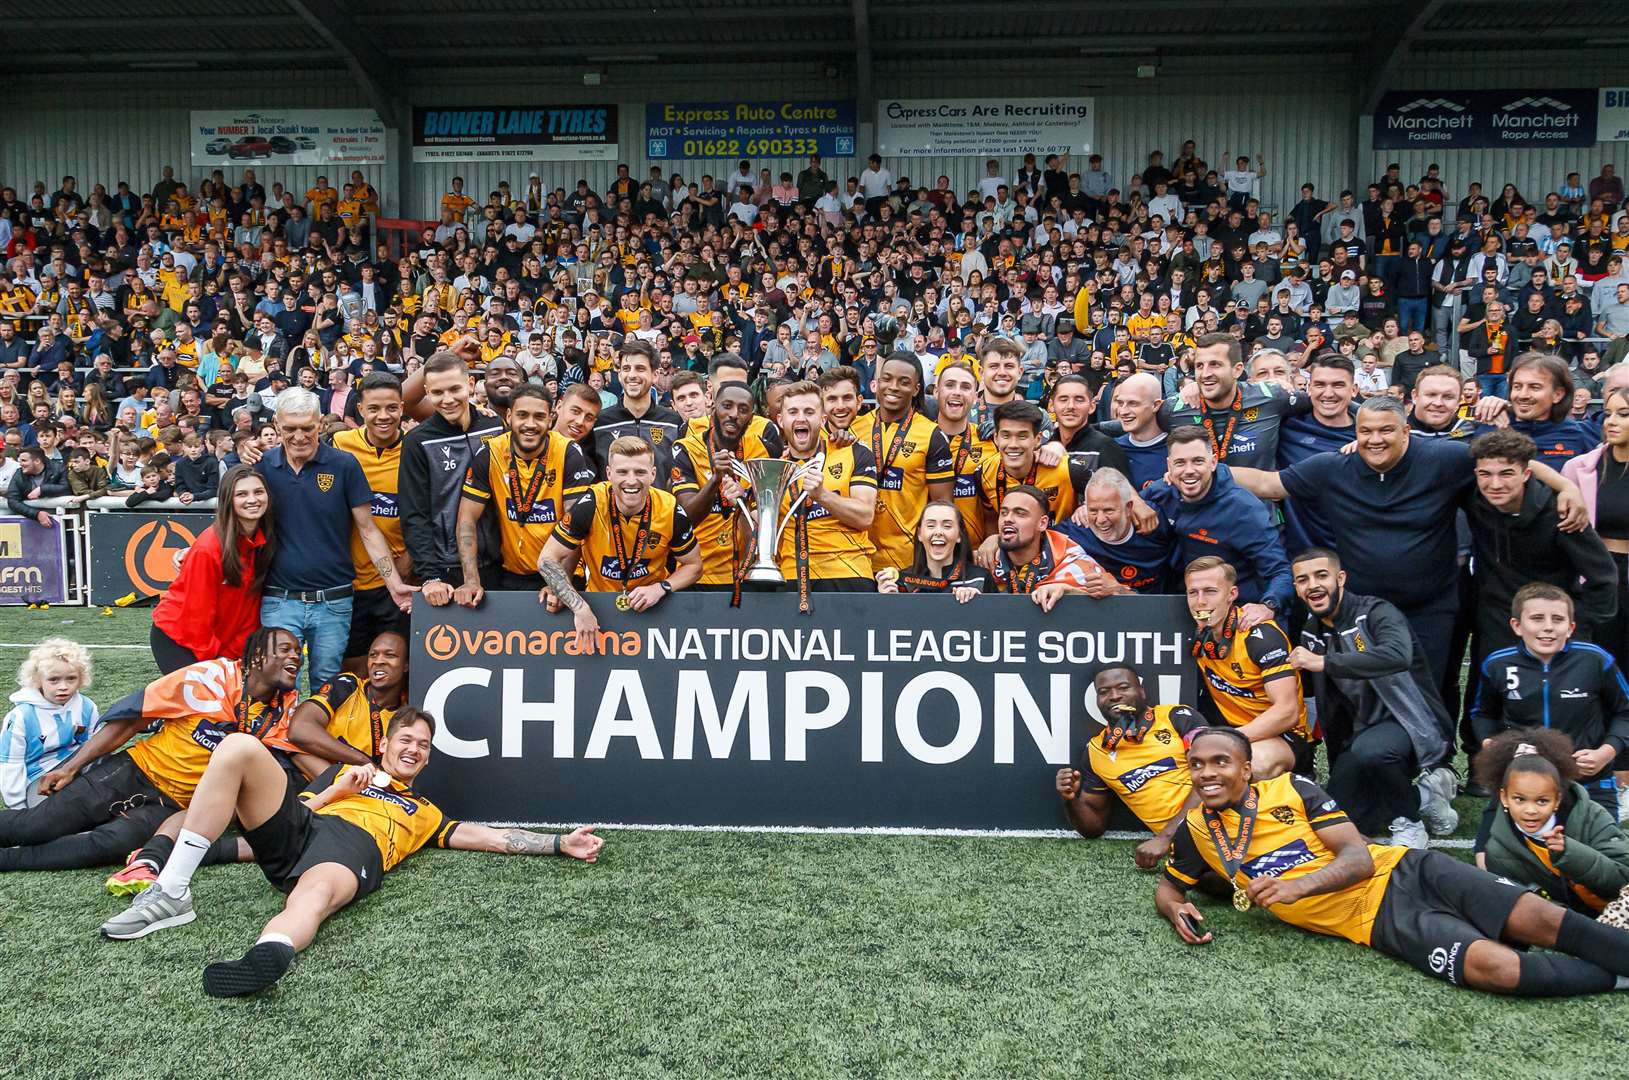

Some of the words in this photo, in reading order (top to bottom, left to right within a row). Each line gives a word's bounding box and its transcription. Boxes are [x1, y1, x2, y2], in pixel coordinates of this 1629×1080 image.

[664, 105, 730, 125] Express
[735, 104, 776, 120] Auto
[780, 103, 838, 119] Centre
[938, 105, 967, 117] Cars
[972, 105, 999, 117] Are
[1005, 103, 1087, 118] Recruiting
[424, 111, 495, 135] BOWER
[497, 110, 545, 134] LANE
[547, 109, 607, 134] TYRES
[1388, 114, 1474, 129] Manchett
[1492, 113, 1580, 127] Manchett
[199, 127, 216, 136] Your
[218, 126, 249, 135] NUMBER
[258, 125, 276, 135] local
[278, 124, 299, 134] Suzuki
[301, 125, 320, 134] team
[650, 127, 674, 137] MOT
[682, 126, 727, 137] Servicing
[736, 126, 774, 137] Repairs
[784, 126, 810, 137] Tyres
[819, 125, 854, 134] Brakes
[1408, 131, 1452, 141] Facilities
[1502, 130, 1529, 140] Rope
[1532, 129, 1568, 139] Access
[684, 139, 740, 156] 01622
[746, 138, 818, 156] 690333
[1227, 441, 1257, 453] chett
[443, 459, 457, 471] 26
[883, 479, 902, 489] hett
[370, 504, 398, 516] chett
[508, 509, 556, 523] Mchett
[24, 585, 42, 594] HITS
[648, 627, 855, 662] NATIONAL
[867, 629, 1026, 663] LEAGUE
[1038, 630, 1182, 665] SOUTH
[1505, 666, 1520, 690] 5
[423, 666, 1182, 765] CHAMPION
